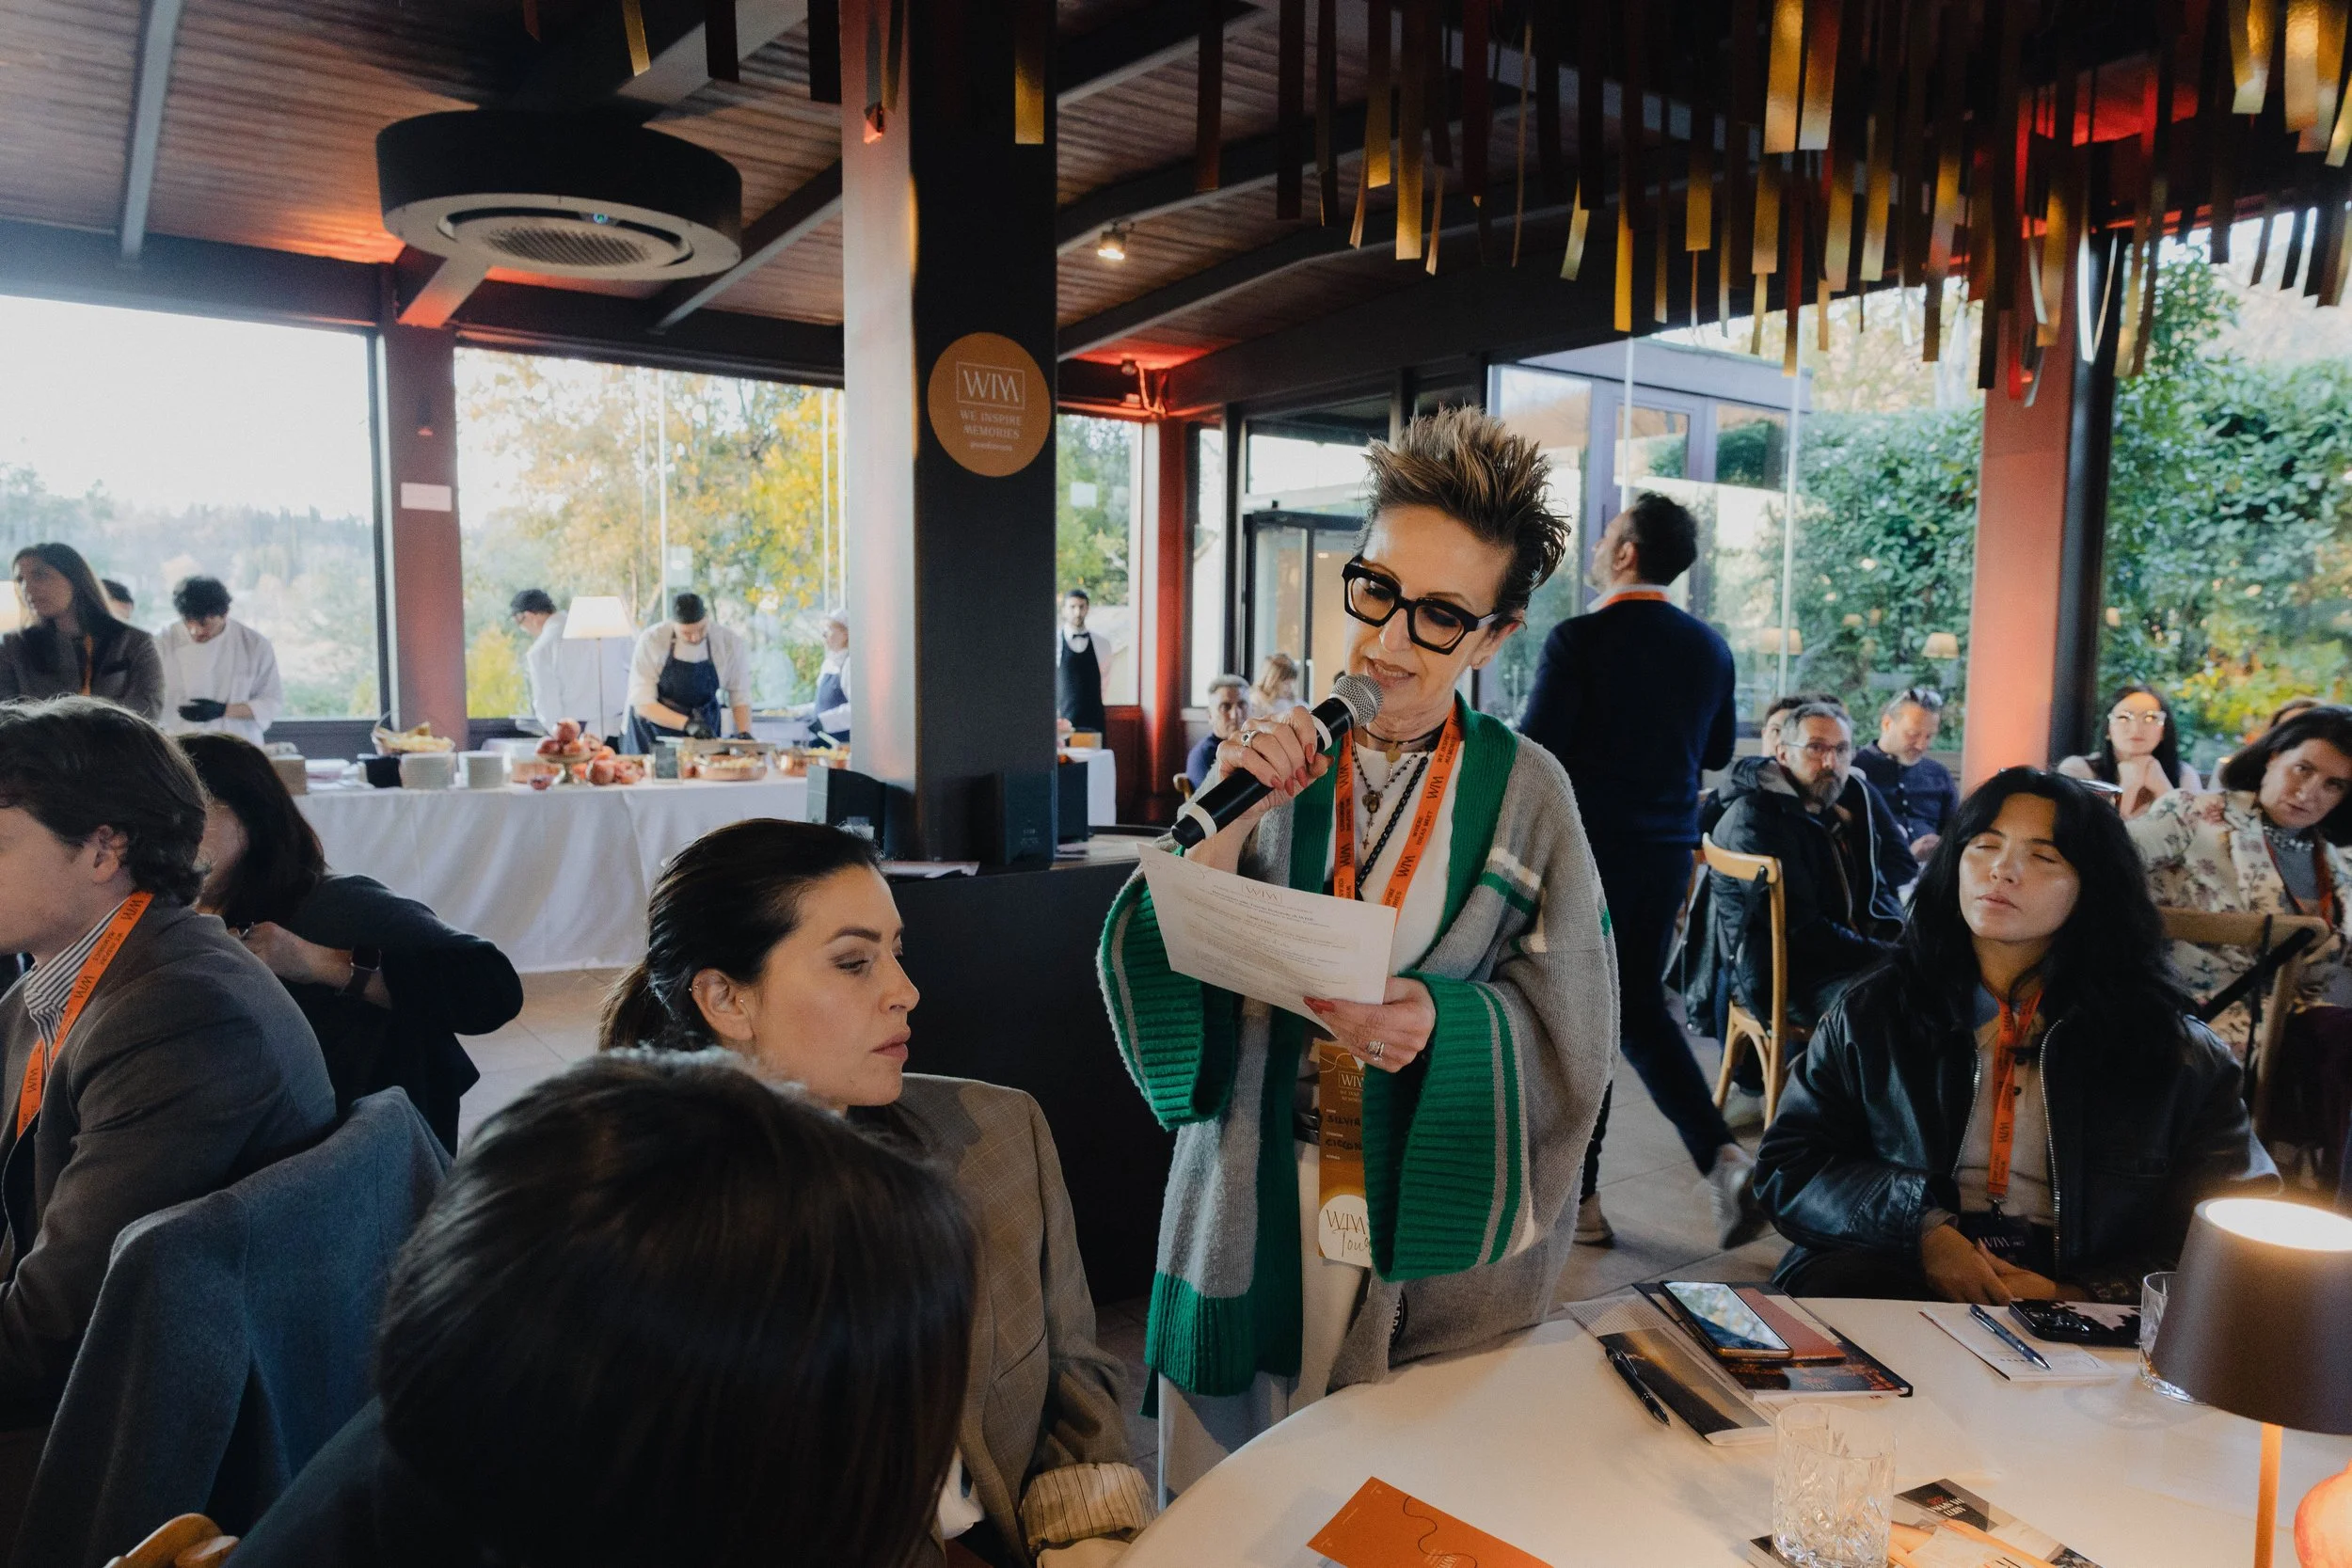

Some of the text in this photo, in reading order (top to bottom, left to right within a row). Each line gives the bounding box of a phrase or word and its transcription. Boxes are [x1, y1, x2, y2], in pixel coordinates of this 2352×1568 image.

[963, 370, 1019, 403] WIM
[960, 409, 976, 421] WE
[963, 424, 1020, 439] MEMORIES
[1426, 776, 1444, 800] WIM
[1396, 854, 1416, 878] WIM
[1246, 885, 1278, 902] WIM
[75, 975, 94, 998] WIM
[1326, 1209, 1365, 1235] WIM
